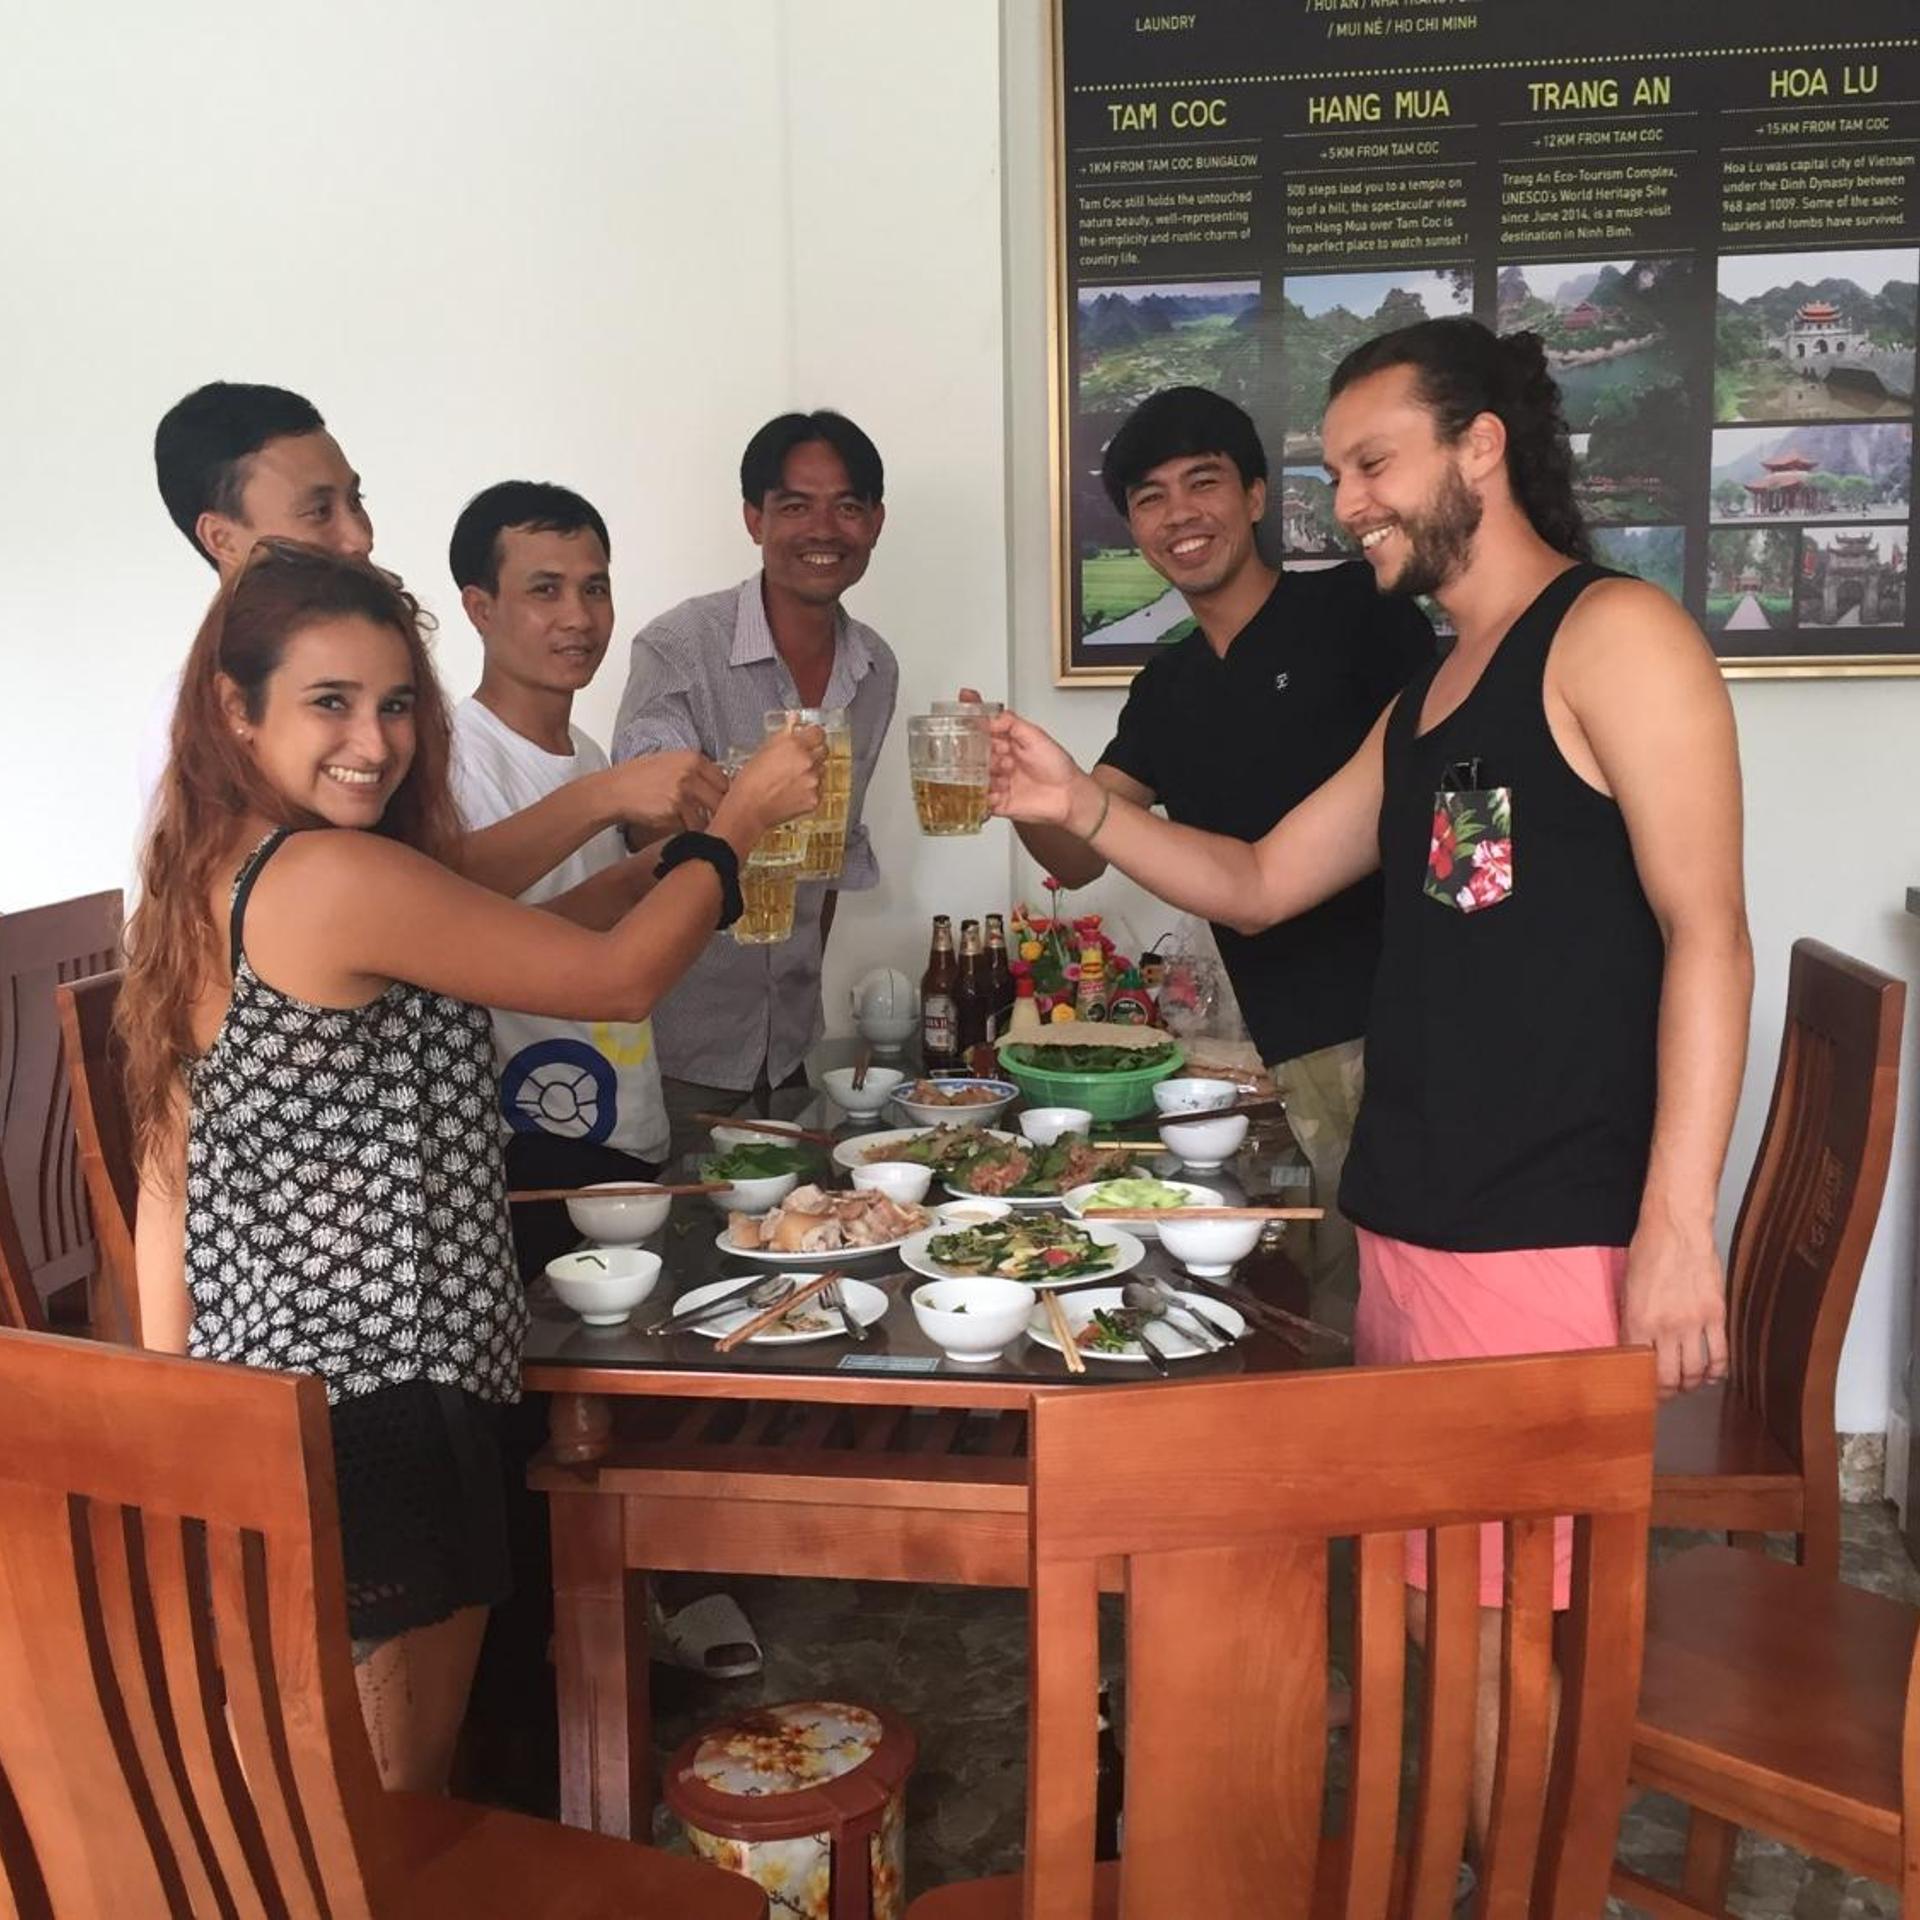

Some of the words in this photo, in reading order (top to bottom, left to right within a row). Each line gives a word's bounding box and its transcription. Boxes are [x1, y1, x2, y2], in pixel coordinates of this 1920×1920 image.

[1136, 14, 1196, 31] LAUNDRY
[1337, 23, 1360, 36] MUI
[1395, 19, 1413, 33] HO
[1416, 18, 1439, 32] CHI
[1442, 15, 1477, 30] MINH
[1770, 68, 1828, 98] HOA
[1844, 65, 1878, 94] LU
[1528, 80, 1618, 111] TRANG
[1633, 76, 1671, 106] AN
[1108, 104, 1157, 131] TAM
[1171, 100, 1227, 129] COC
[1309, 95, 1381, 124] HANG
[1395, 90, 1450, 119] MUA
[1767, 122, 1799, 135] 15KM
[1802, 121, 1836, 134] FROM
[1839, 119, 1863, 132] TAM
[1865, 118, 1889, 130] COC
[1543, 133, 1576, 148] 12KM
[1578, 131, 1610, 145] FROM
[1613, 131, 1637, 143] TAM
[1640, 129, 1664, 141] COC
[1357, 144, 1388, 158] FROM
[1391, 142, 1415, 156] TAM
[1416, 141, 1439, 154] COC
[1113, 160, 1144, 173] FROM
[1147, 159, 1169, 171] TAM
[1171, 158, 1193, 170] COC
[1196, 154, 1258, 168] BUNGALOW
[1723, 162, 1746, 174] Hoa
[1765, 161, 1788, 171] was
[1790, 157, 1829, 172] capital
[1854, 156, 1865, 167] of
[1868, 154, 1915, 167] Vietnam
[1502, 173, 1534, 187] Trang
[1535, 173, 1551, 183] An
[1554, 168, 1624, 183] Eco-Tourism
[1723, 180, 1755, 193] under
[1759, 179, 1777, 191] the
[1809, 176, 1855, 192] Dynasty
[1856, 174, 1905, 187] between
[1287, 184, 1307, 197] 500
[1308, 183, 1337, 198] steps
[1364, 182, 1384, 195] you
[1386, 181, 1397, 192] to
[1448, 178, 1462, 188] on
[1560, 188, 1593, 202] World
[1595, 186, 1643, 201] Heritage
[1351, 201, 1369, 212] the
[1371, 198, 1433, 214] spectacular
[1722, 200, 1742, 213] 968
[1745, 199, 1766, 212] and
[1802, 197, 1834, 210] Some
[1836, 195, 1848, 207] of
[1851, 194, 1870, 206] the
[1314, 220, 1343, 235] Hang
[1344, 219, 1367, 232] Mua
[1370, 219, 1393, 231] over
[1396, 217, 1419, 229] Tam
[1421, 216, 1440, 228] Coc
[1501, 211, 1530, 224] since
[1764, 217, 1785, 230] and
[1826, 215, 1852, 227] have
[1204, 229, 1238, 241] charm
[1306, 238, 1345, 255] perfect
[1347, 238, 1375, 253] place
[1377, 238, 1389, 250] to
[1390, 235, 1422, 249] watch
[1424, 234, 1462, 247] sunset
[1500, 229, 1562, 243] destination
